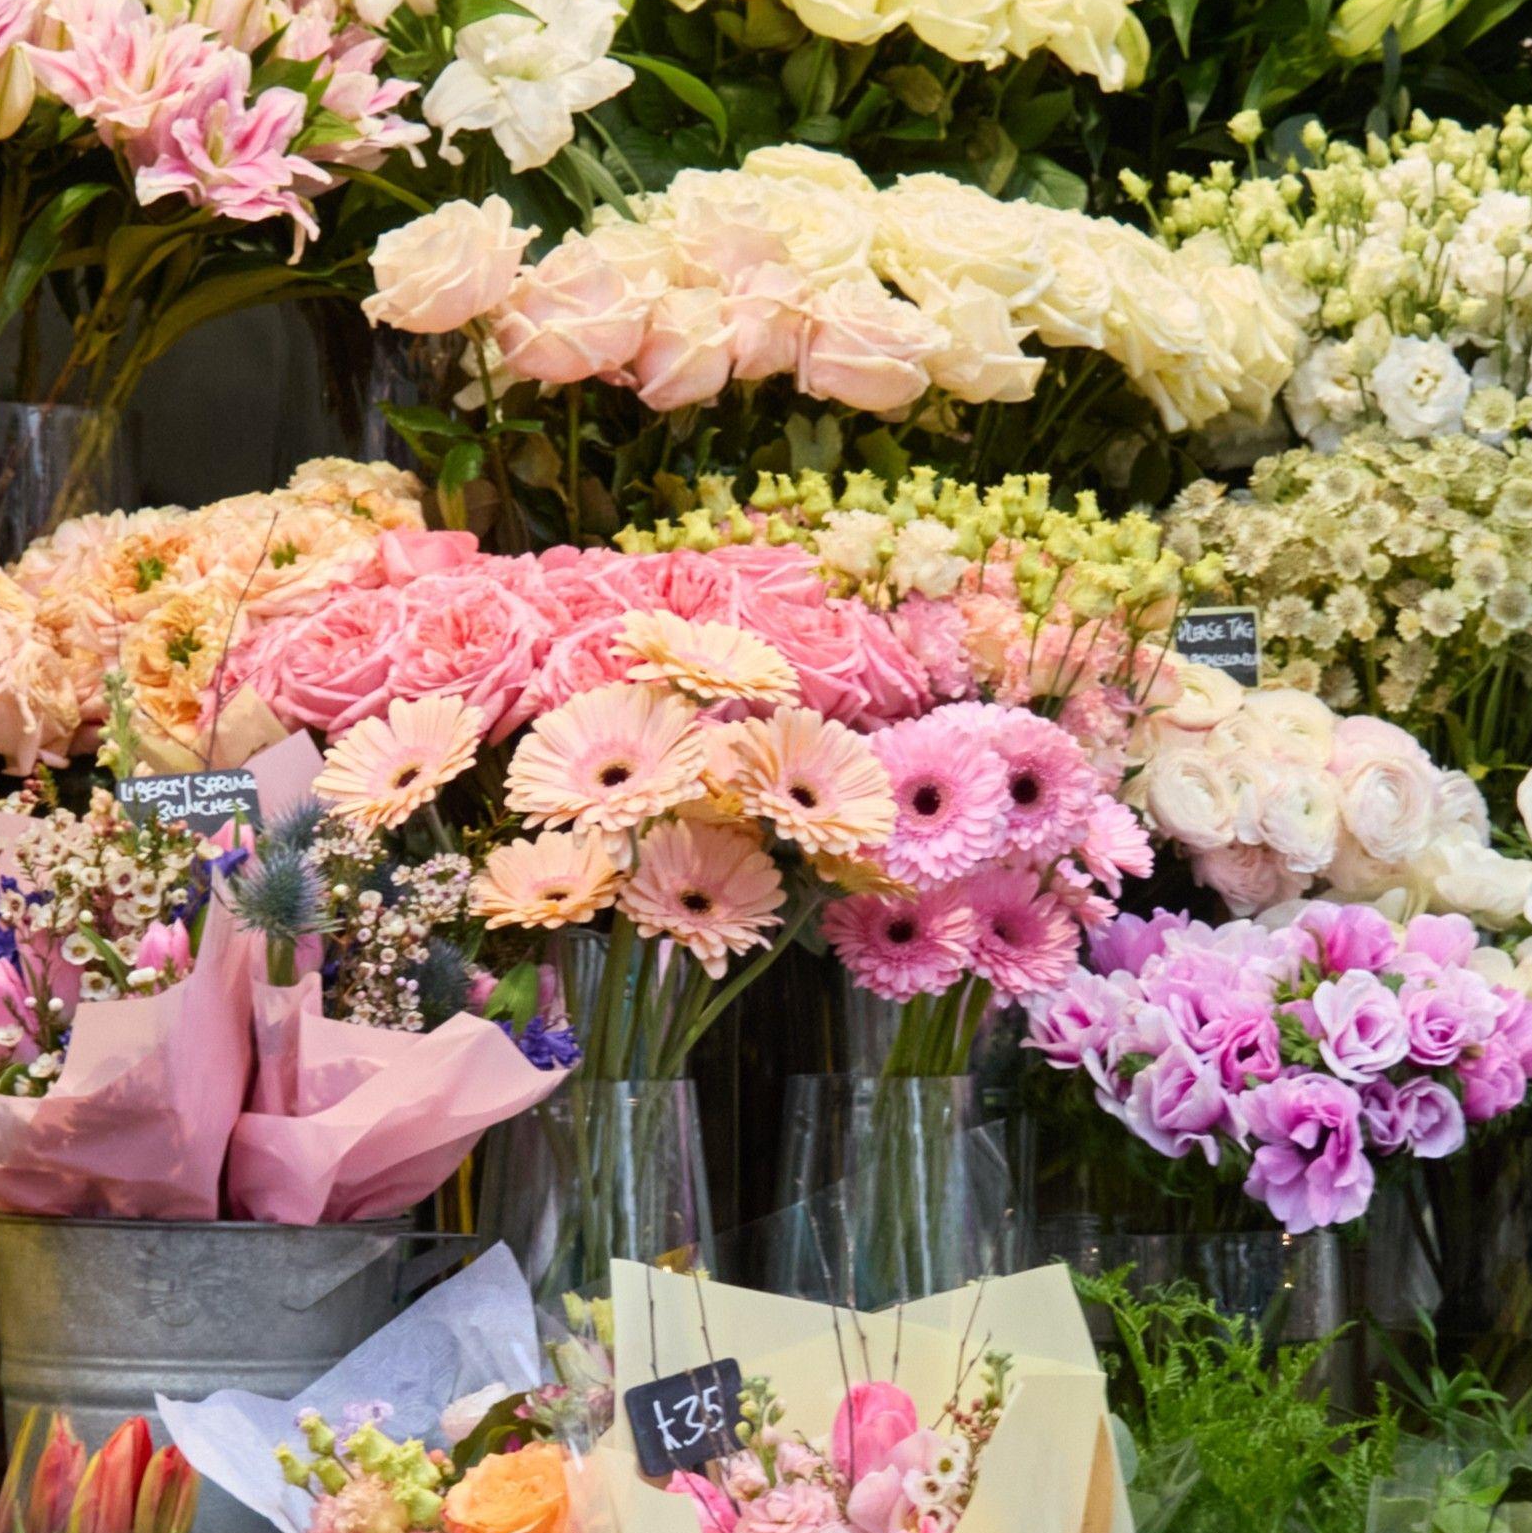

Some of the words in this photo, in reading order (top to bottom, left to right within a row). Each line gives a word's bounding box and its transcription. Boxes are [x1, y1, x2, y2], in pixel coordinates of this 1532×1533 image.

[1226, 616, 1255, 641] TAG
[156, 797, 251, 822] BUNCHES
[652, 1385, 725, 1451] £35
